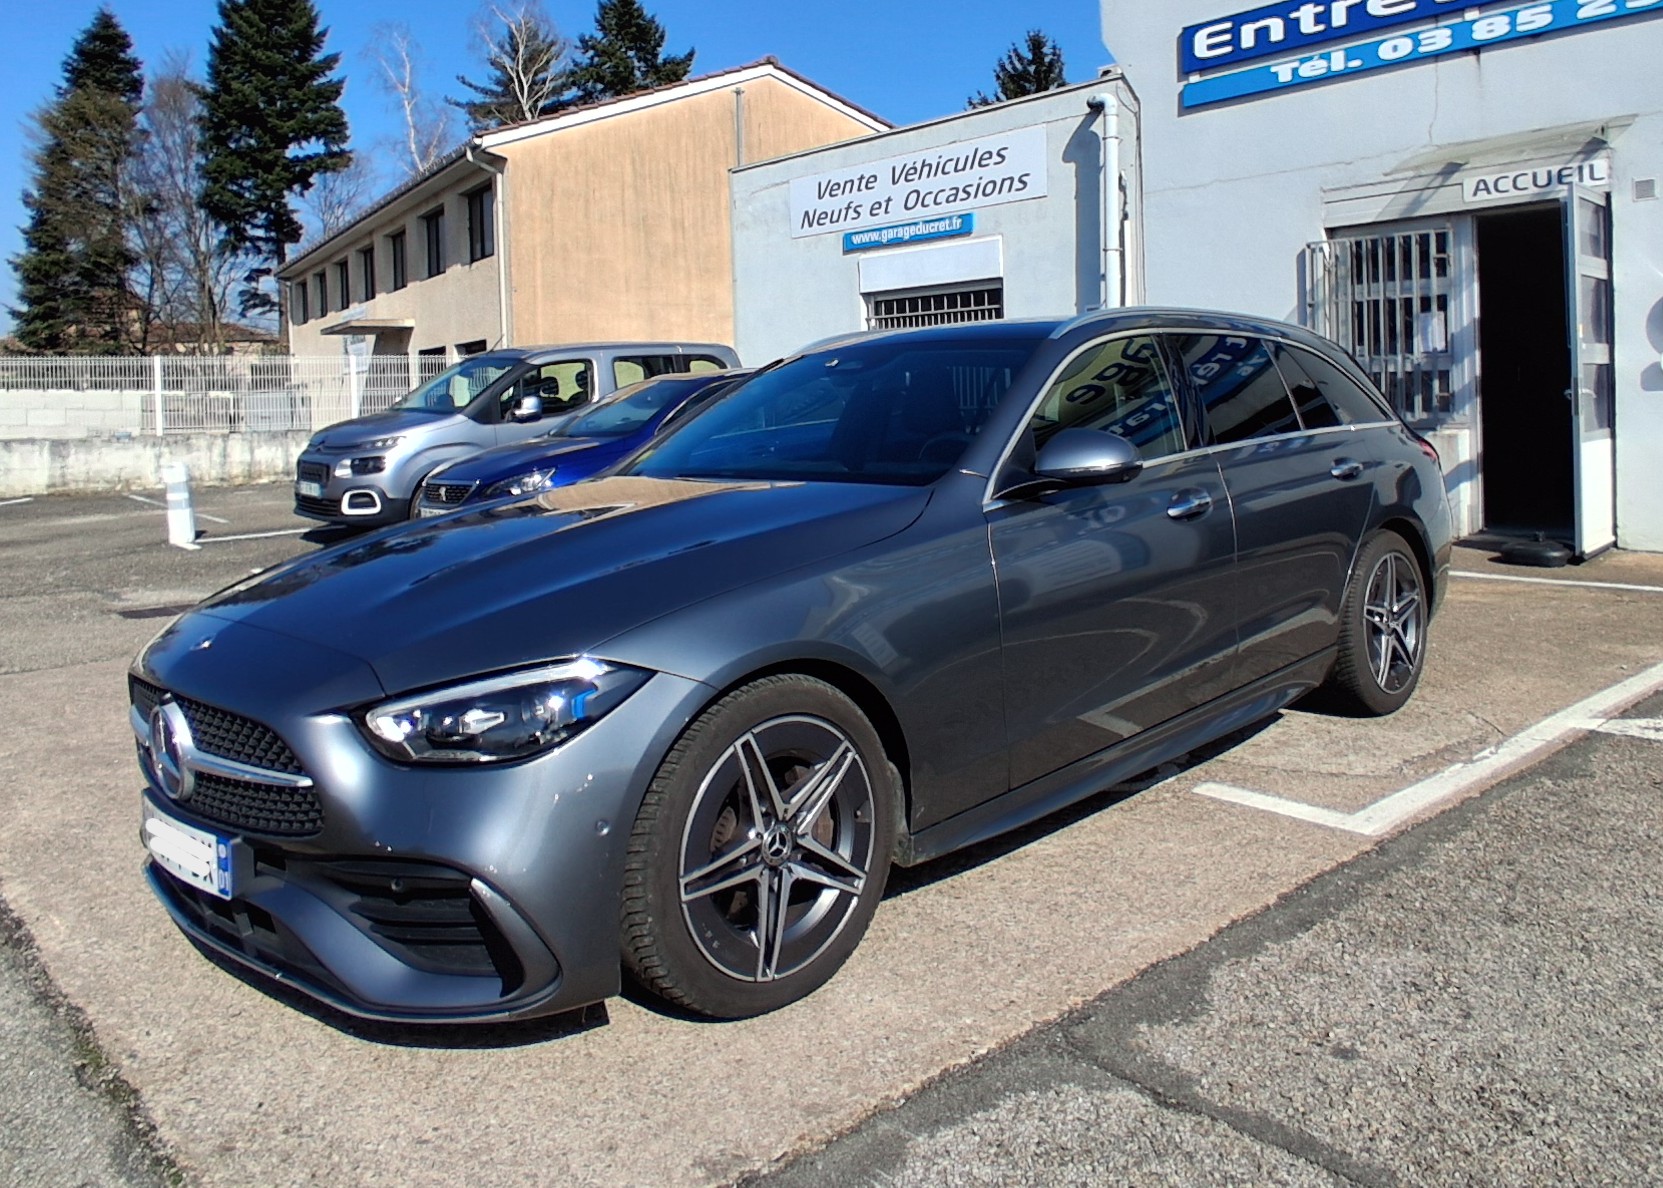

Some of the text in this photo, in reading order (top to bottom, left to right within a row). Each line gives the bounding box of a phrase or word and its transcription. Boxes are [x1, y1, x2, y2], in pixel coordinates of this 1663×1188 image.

[1194, 0, 1461, 58] Entre
[1270, 50, 1363, 83] Tél.
[1377, 27, 1453, 60] 03
[1471, 4, 1554, 40] 85
[800, 172, 1031, 230] Neufs et Occasions
[817, 146, 1009, 200] Vente Véhicules
[1472, 163, 1606, 197] ACCUEIL
[851, 216, 963, 244] www.garageducret.fr
